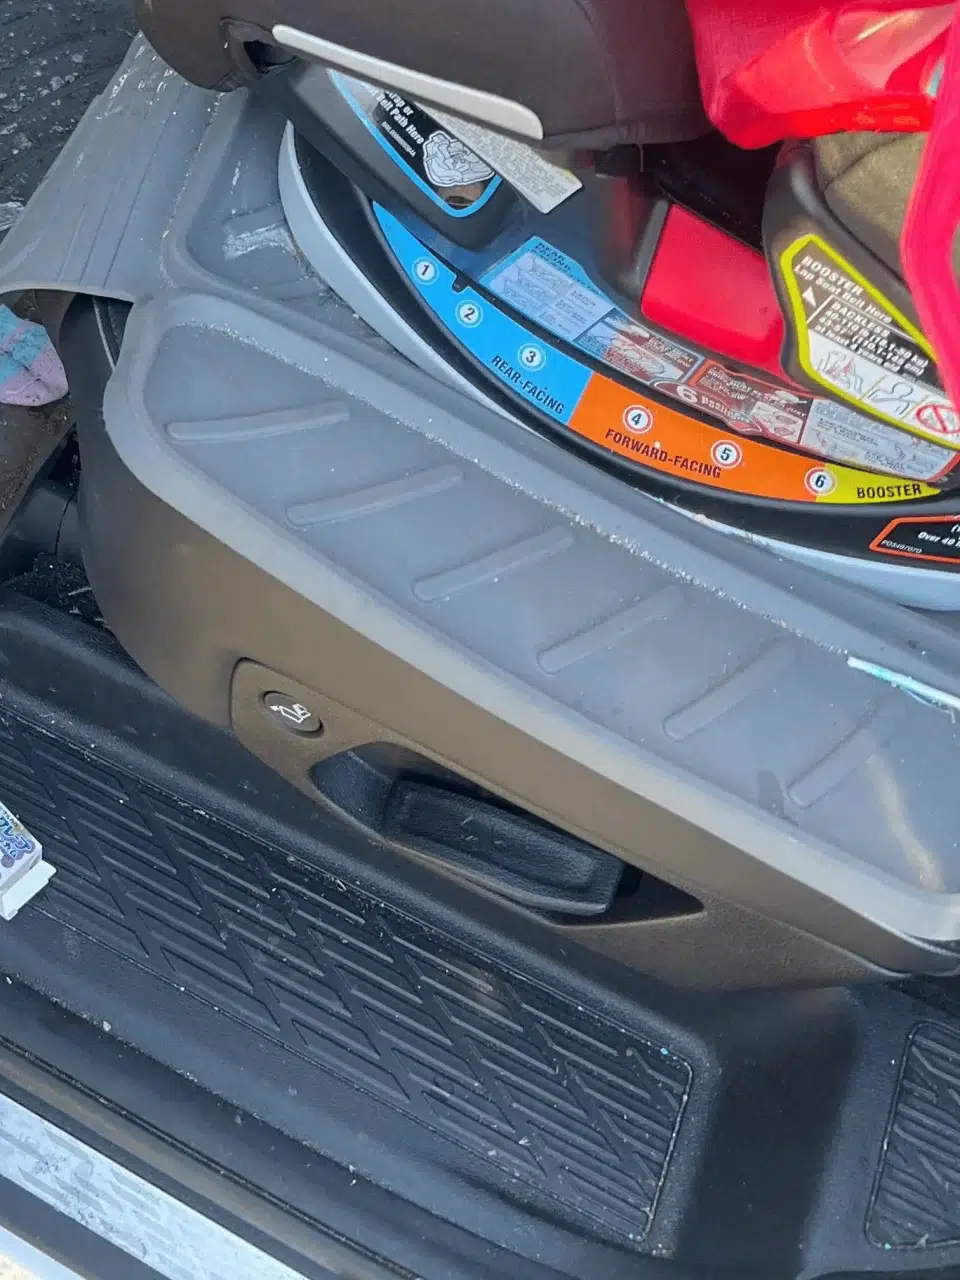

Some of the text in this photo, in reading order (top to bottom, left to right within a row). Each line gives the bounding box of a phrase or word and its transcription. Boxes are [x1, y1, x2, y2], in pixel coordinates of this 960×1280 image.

[386, 89, 414, 116] trap or
[376, 93, 394, 112] Belt
[389, 107, 410, 128] Path
[405, 124, 426, 145] Here
[422, 264, 430, 276] 1
[800, 255, 864, 297] BOOSTER
[793, 264, 893, 324] Lap Seat Belt Here
[464, 307, 476, 320] 2
[825, 307, 860, 332] 40-110
[831, 300, 891, 339] BACKLESS
[526, 351, 536, 364] 3
[825, 329, 850, 347] least
[856, 346, 884, 367] years
[492, 355, 565, 415] REAR-FACING
[677, 385, 698, 404] 6
[632, 413, 642, 425] 4
[606, 428, 721, 479] FORWARD-FACING
[721, 448, 731, 461] 5
[815, 474, 826, 488] 6
[857, 483, 922, 499] BOOSTER
[918, 531, 941, 542] Over
[942, 537, 956, 546] 40
